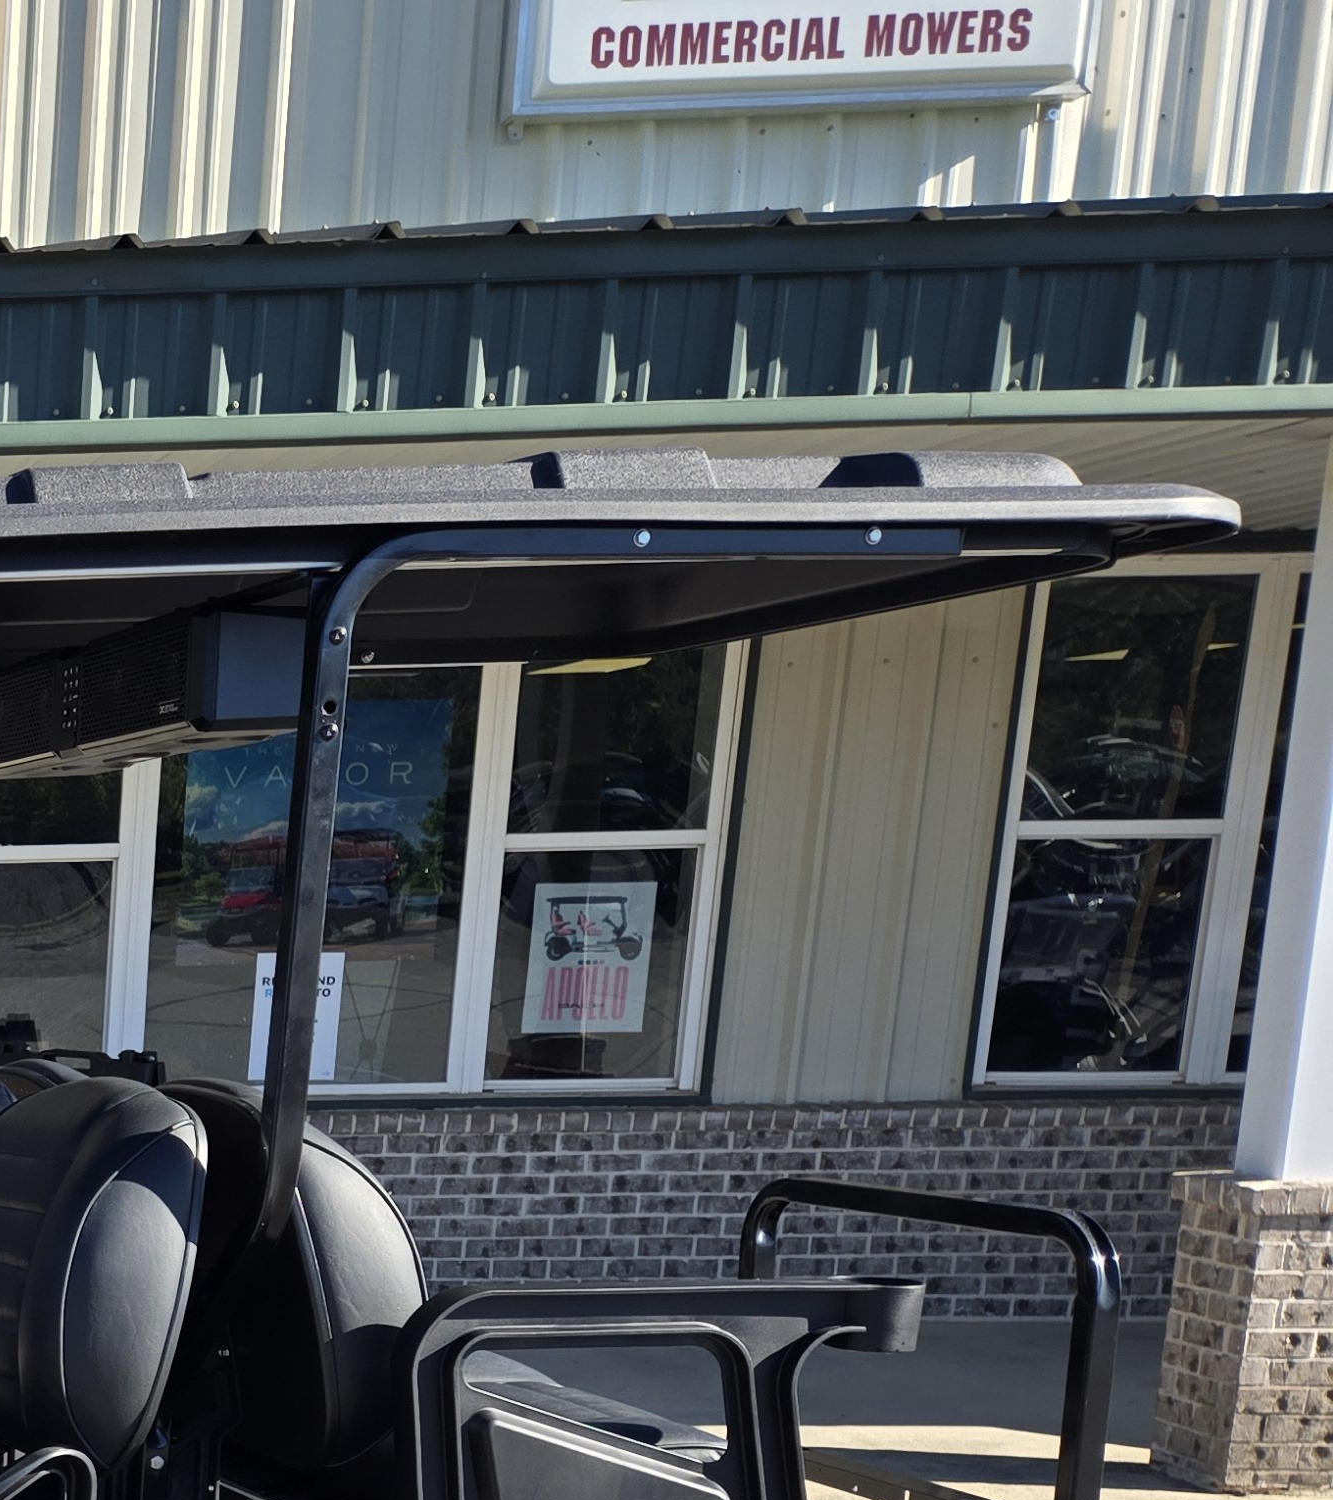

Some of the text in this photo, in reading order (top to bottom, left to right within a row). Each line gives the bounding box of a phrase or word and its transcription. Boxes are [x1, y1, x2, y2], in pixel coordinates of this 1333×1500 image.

[590, 8, 1033, 69] COMMERCIAL MOWERS
[224, 761, 414, 788] VAOR
[540, 966, 630, 1021] APOLLO
